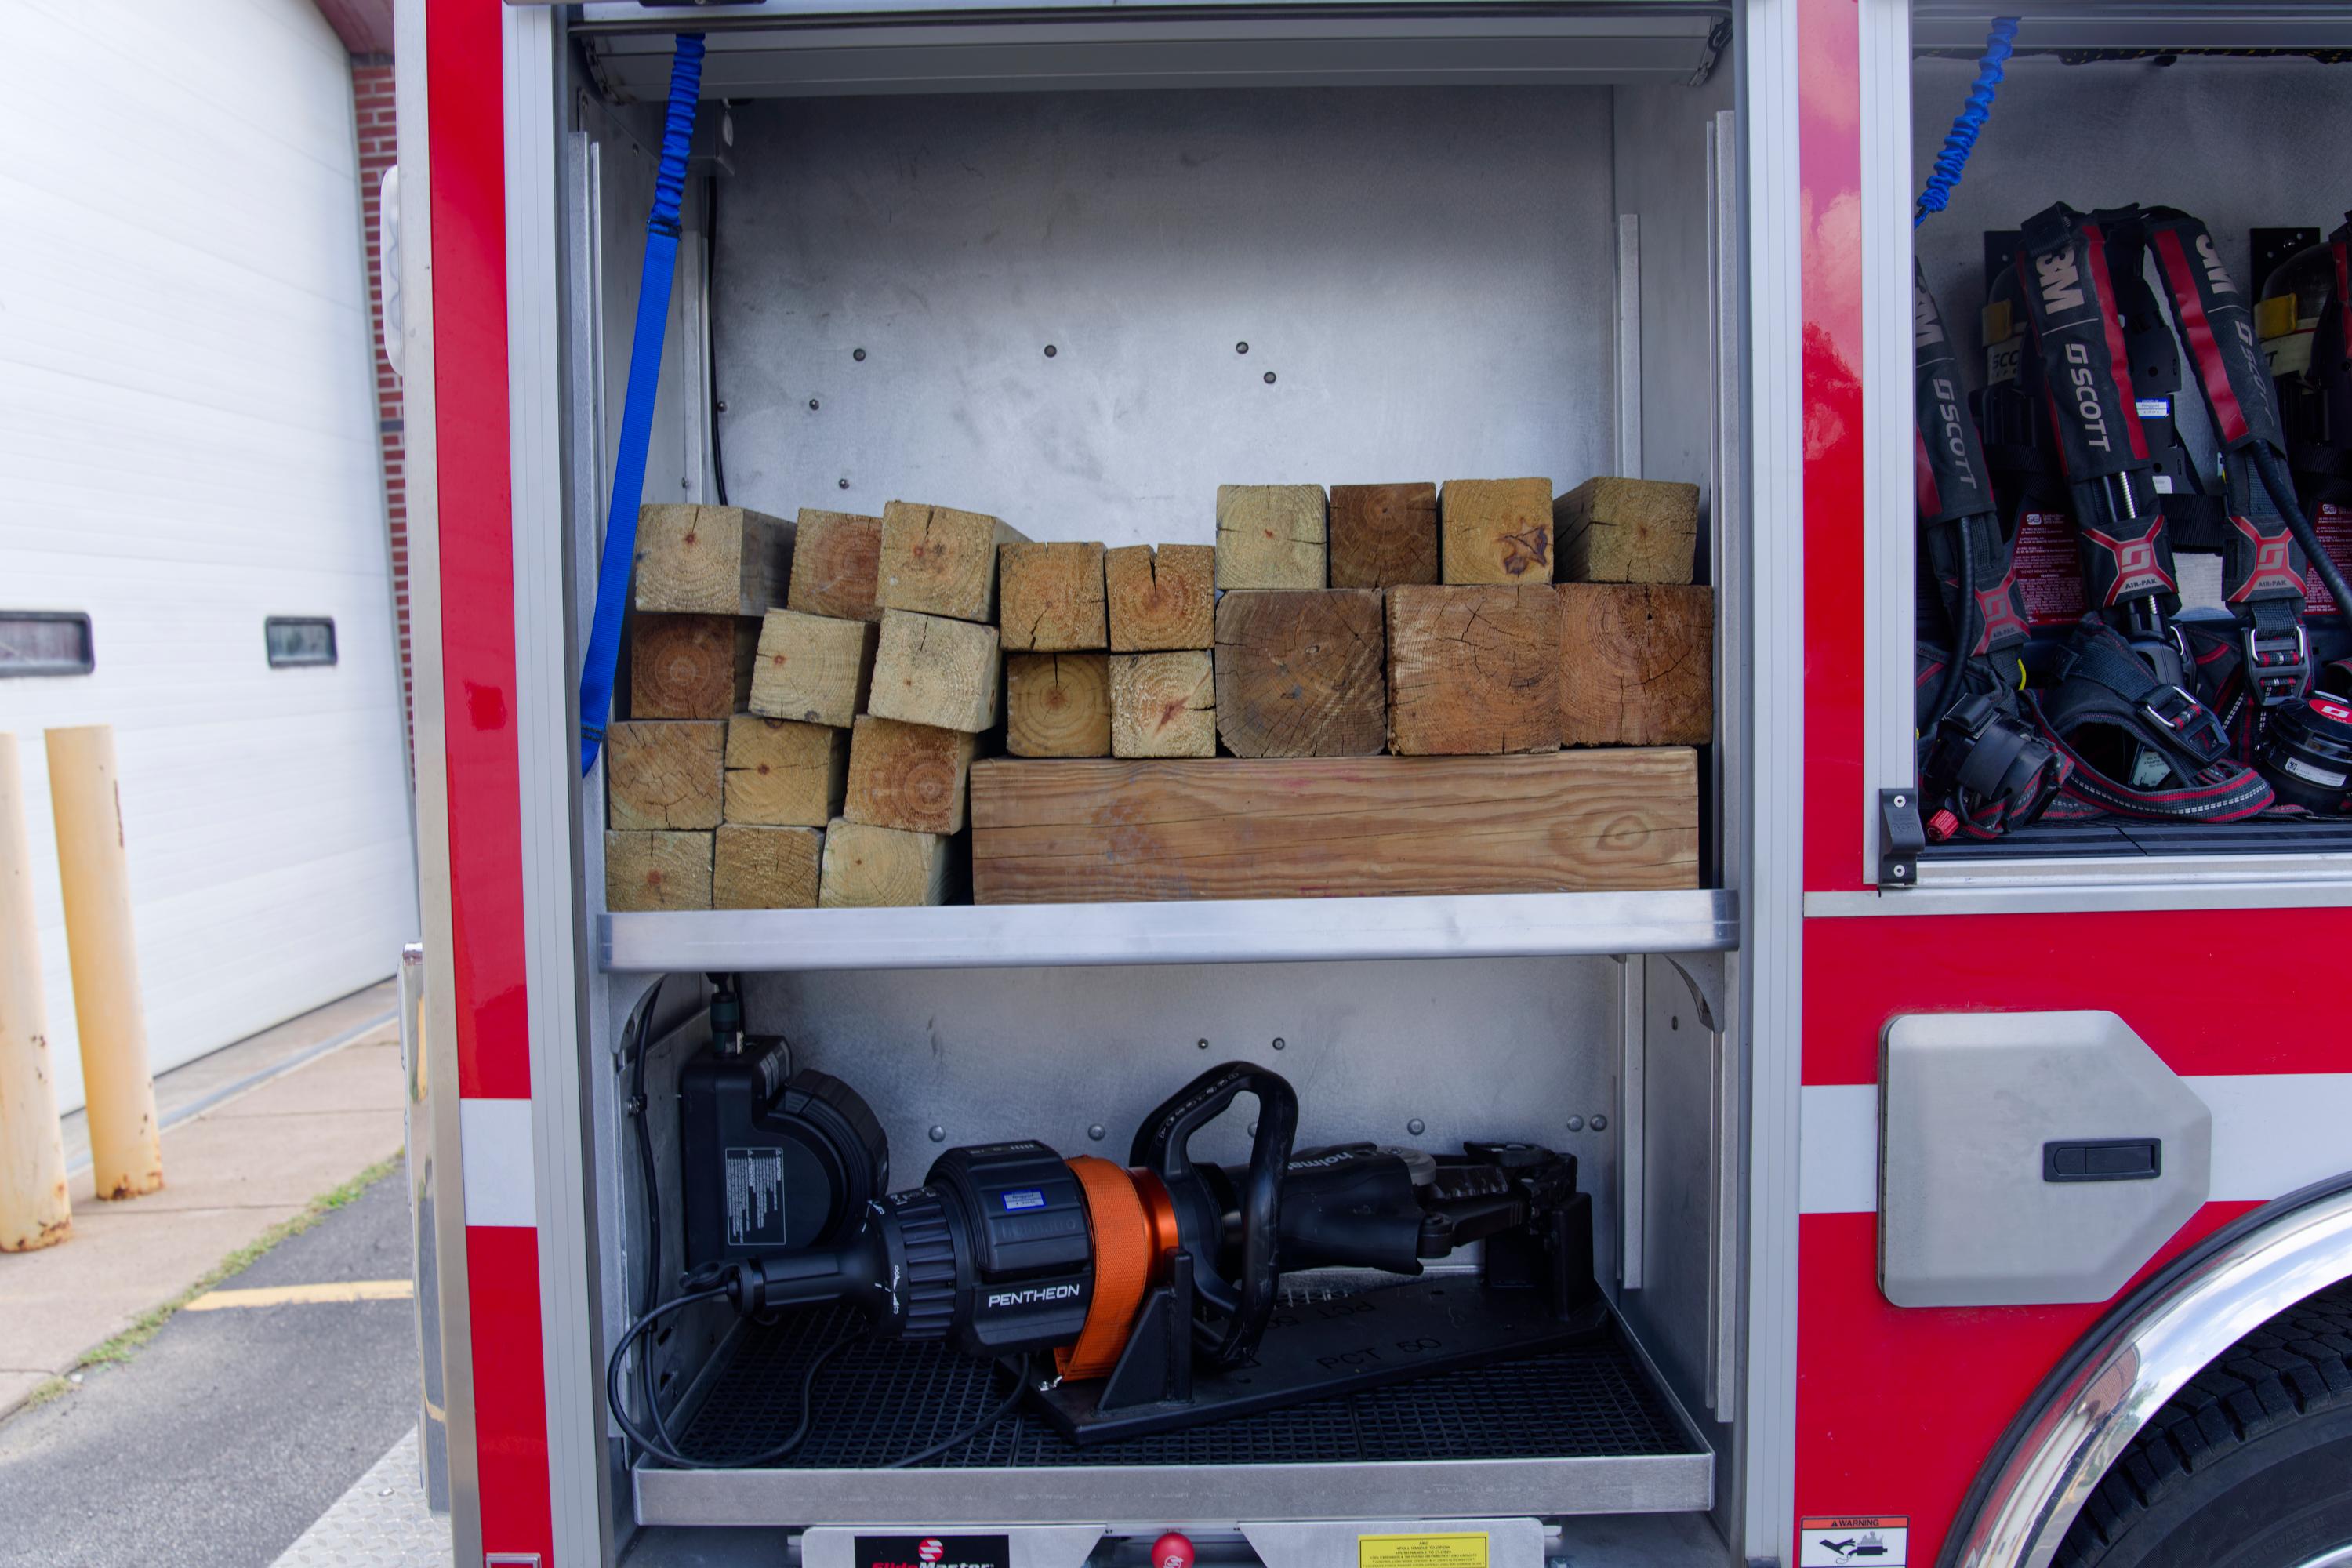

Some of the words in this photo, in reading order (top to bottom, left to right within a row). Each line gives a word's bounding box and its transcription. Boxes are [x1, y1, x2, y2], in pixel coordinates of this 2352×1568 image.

[2035, 245, 2085, 315] 3M
[2240, 343, 2275, 428] SCOTT
[2071, 368, 2111, 452] SCOTT
[1939, 403, 1978, 490] SCOTT
[2125, 577, 2158, 590] AIR-PAK
[2257, 579, 2288, 588] AIR-PAK
[1992, 625, 2016, 637] AIR-PAK
[988, 1283, 1080, 1308] PENTHEON
[1317, 1348, 1381, 1370] PCT
